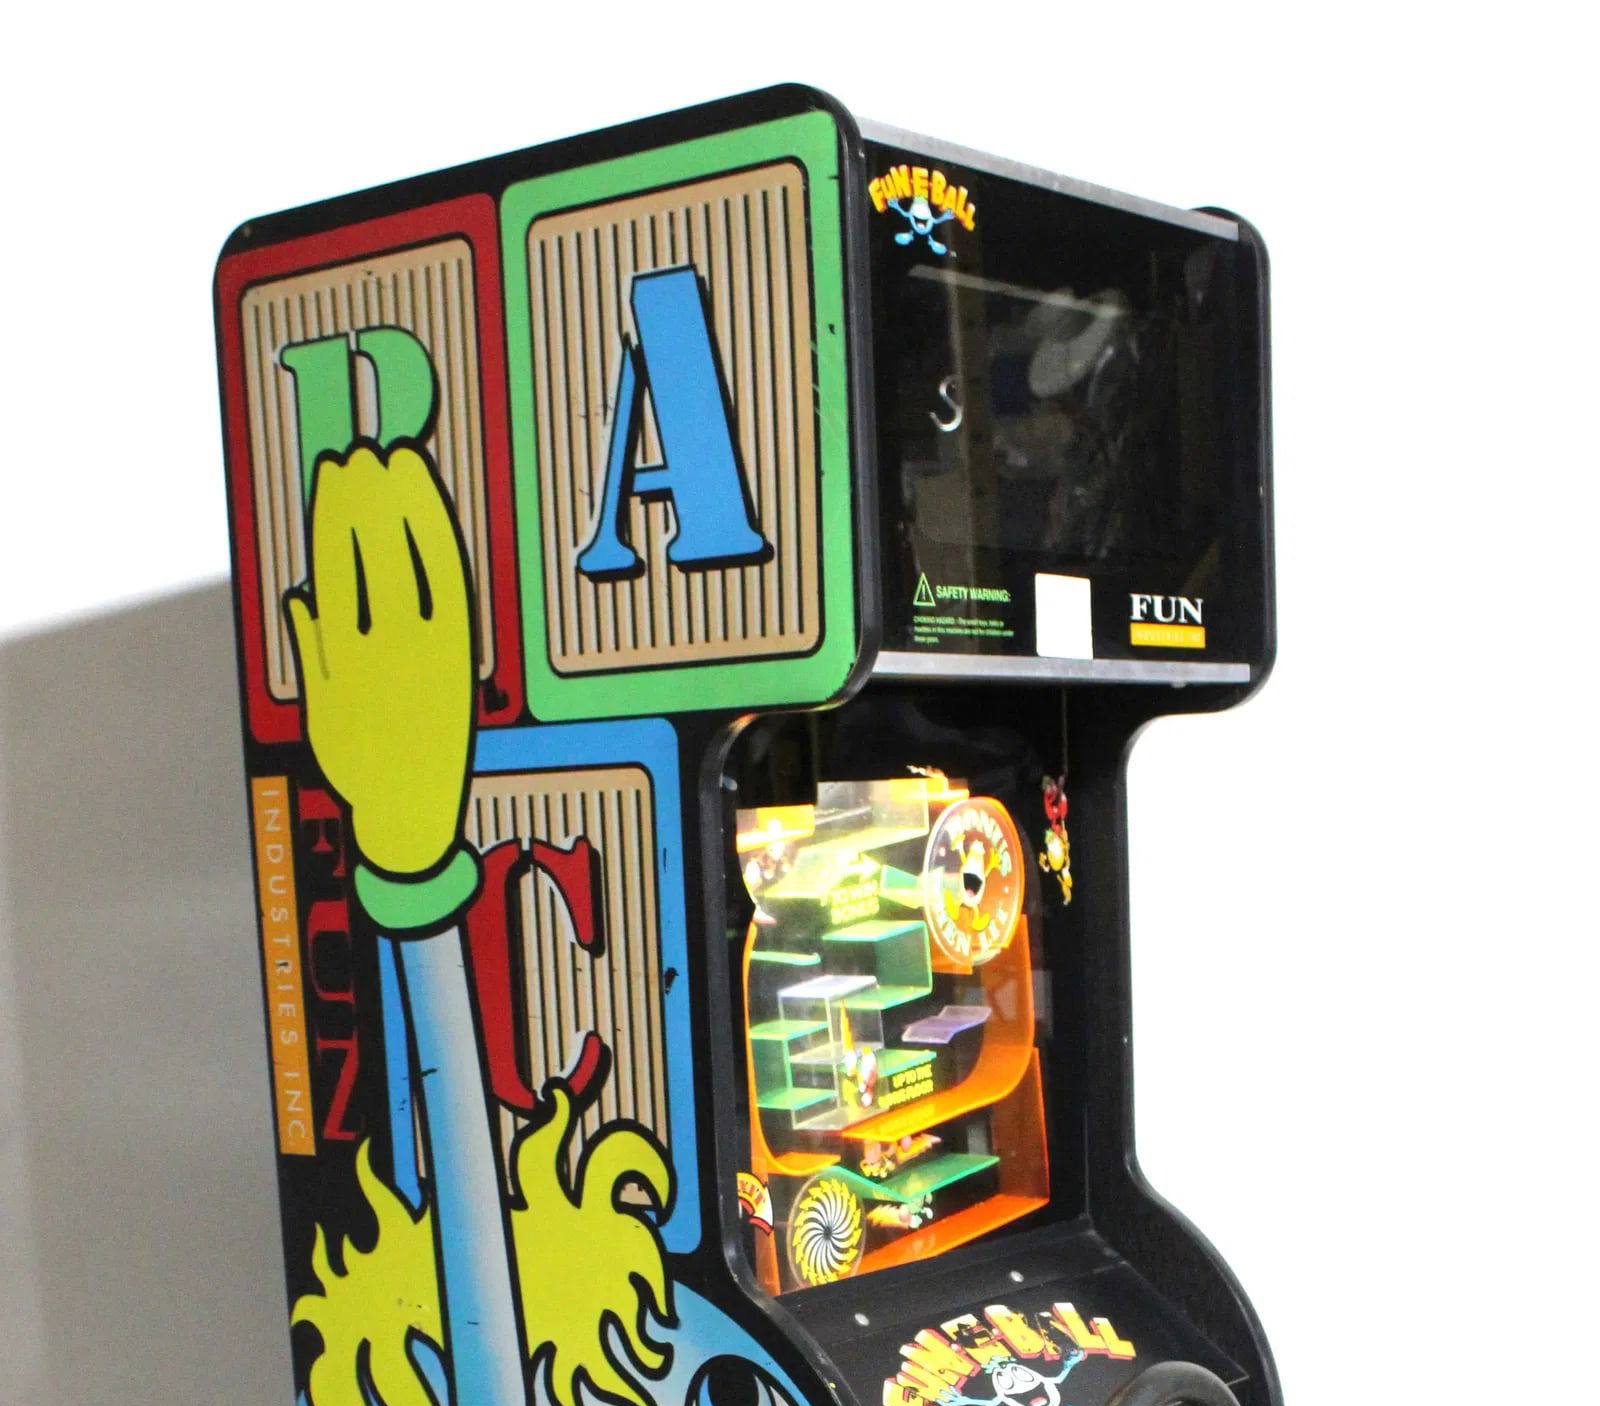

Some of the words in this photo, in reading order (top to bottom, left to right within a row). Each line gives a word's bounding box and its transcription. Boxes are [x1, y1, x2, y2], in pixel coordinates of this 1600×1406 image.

[577, 264, 774, 583] A
[936, 584, 968, 600] SAFETY
[1128, 592, 1203, 625] FUN
[260, 788, 300, 1047] INDUSTRIES
